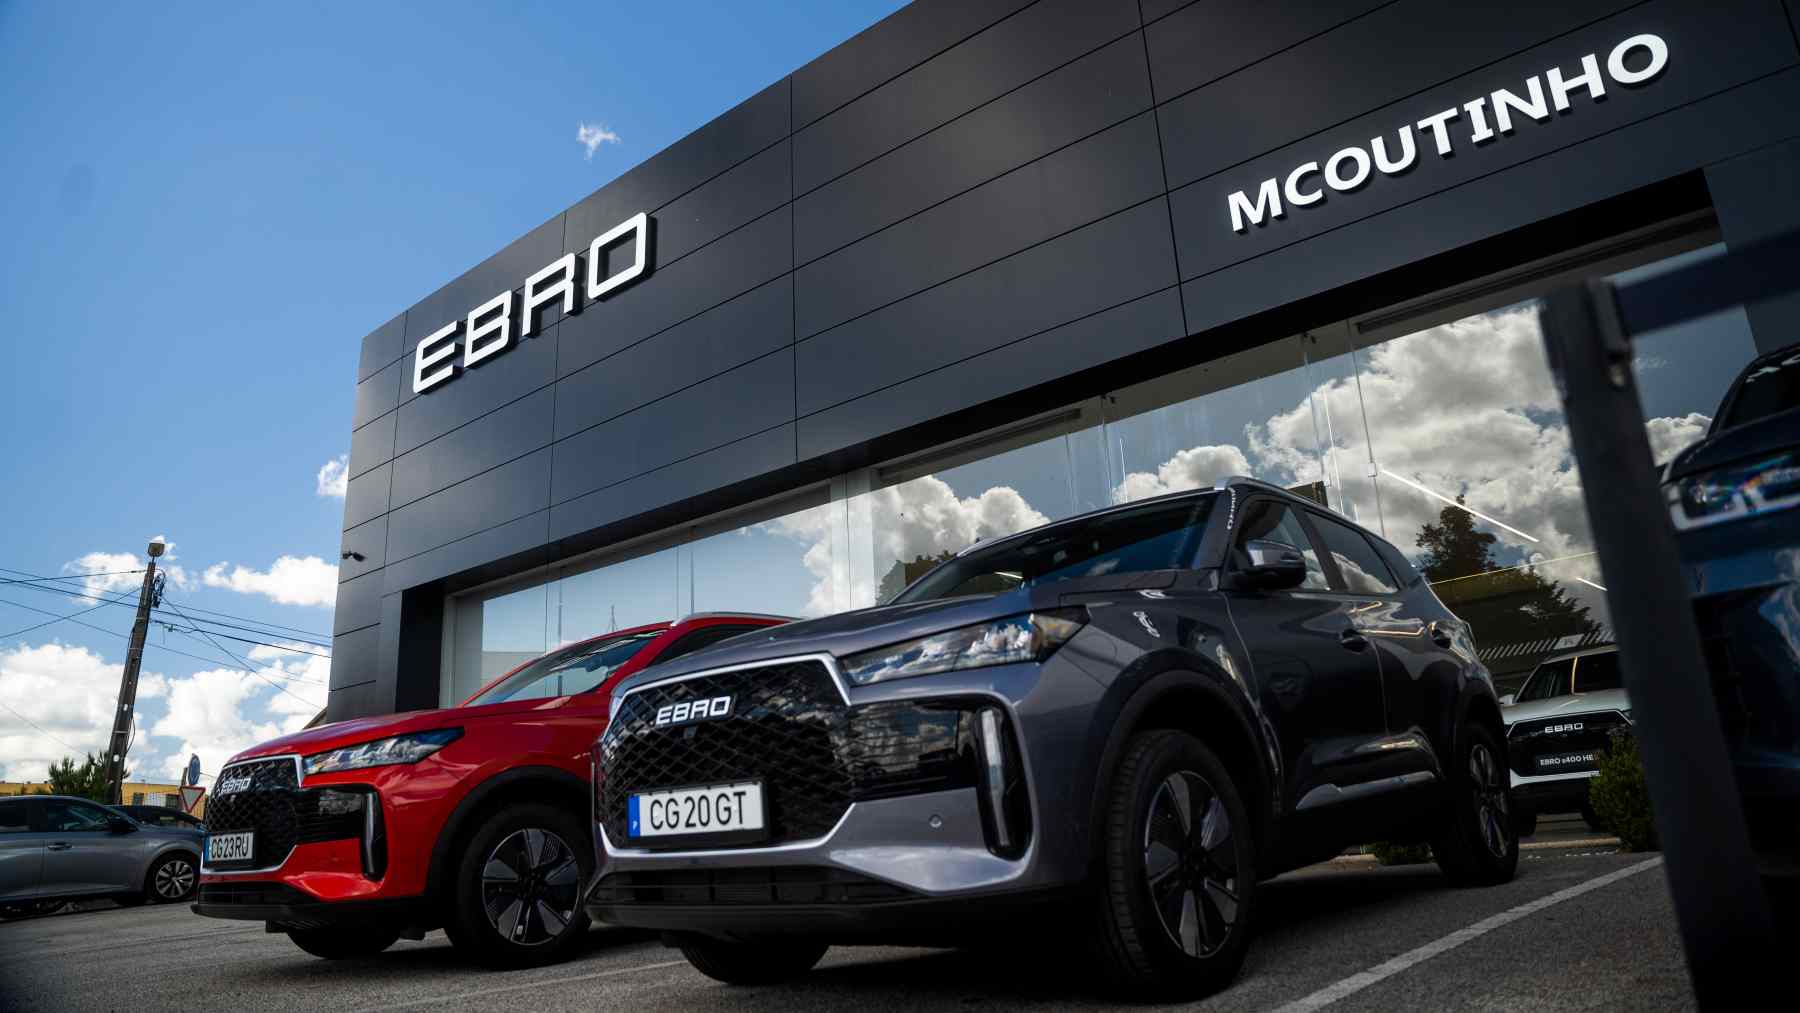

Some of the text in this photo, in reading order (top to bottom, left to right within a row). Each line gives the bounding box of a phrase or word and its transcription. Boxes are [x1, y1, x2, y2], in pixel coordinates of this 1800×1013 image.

[1227, 33, 1669, 232] MCOUTINHO
[413, 212, 647, 394] EBRO
[655, 695, 731, 725] EBRO
[1544, 722, 1583, 733] EBRO
[1540, 757, 1561, 766] EBRO
